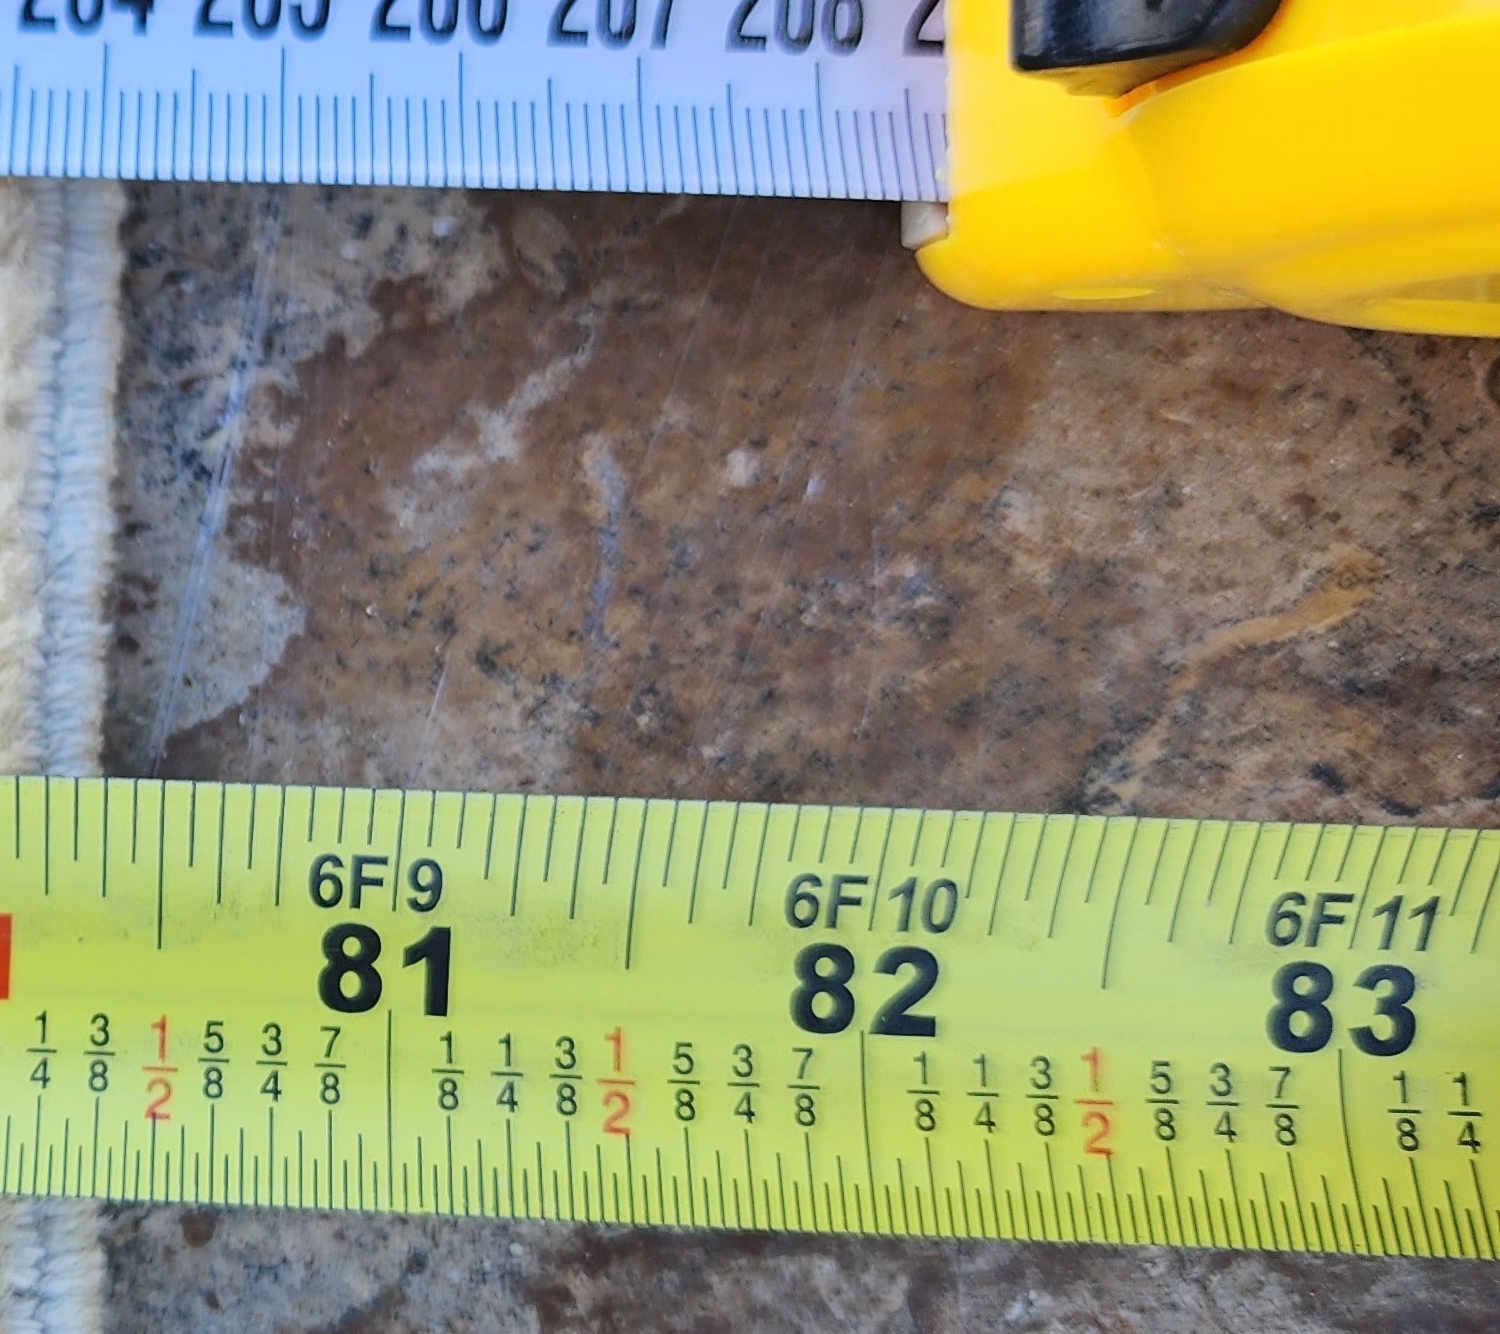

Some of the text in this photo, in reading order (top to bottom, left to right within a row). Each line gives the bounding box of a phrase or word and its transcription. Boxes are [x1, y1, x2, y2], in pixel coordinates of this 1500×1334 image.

[317, 923, 451, 1017] 81
[789, 942, 939, 1037] 82
[1264, 961, 1417, 1056] 83
